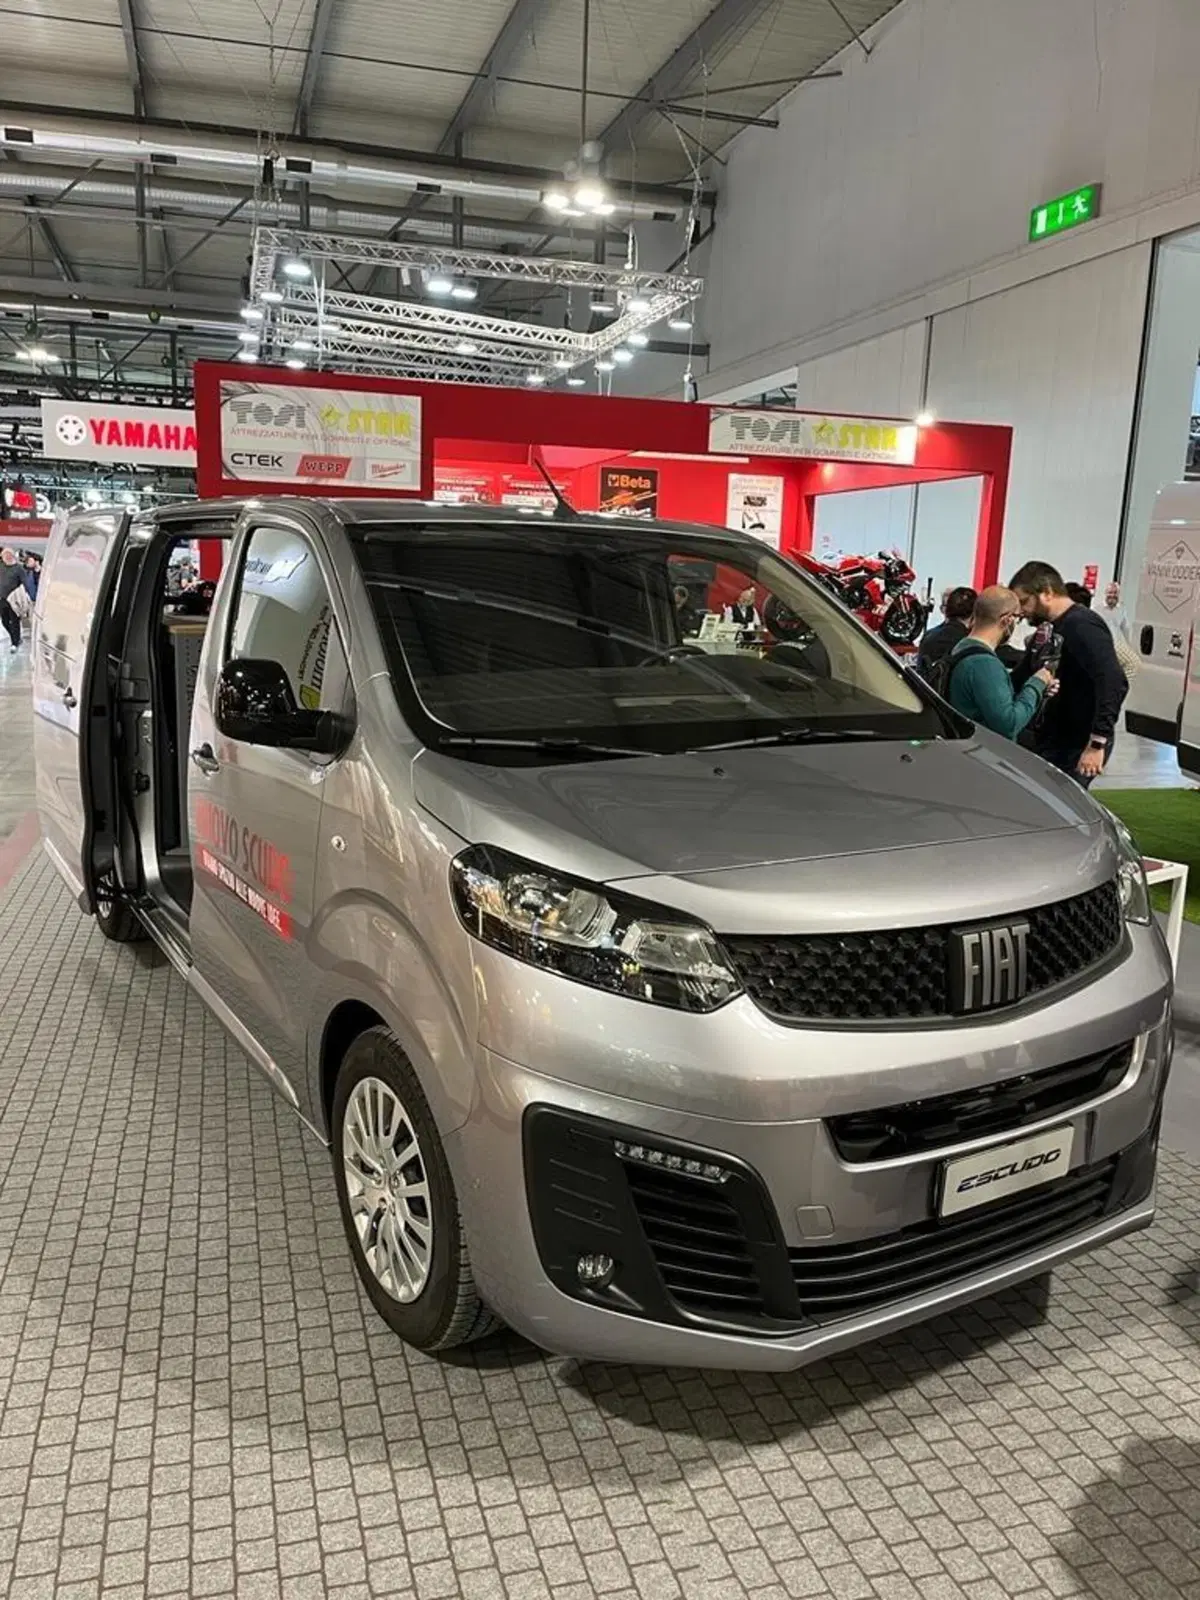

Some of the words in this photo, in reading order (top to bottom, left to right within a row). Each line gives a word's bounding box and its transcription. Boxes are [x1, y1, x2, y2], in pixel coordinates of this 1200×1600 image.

[89, 419, 197, 450] YAMAHA
[347, 410, 411, 437] STAR
[838, 424, 897, 450] STAR
[231, 452, 283, 468] CTEK
[620, 475, 651, 489] Beta
[962, 923, 1030, 1010] FIAT
[956, 1148, 1062, 1194] ESCUDO
